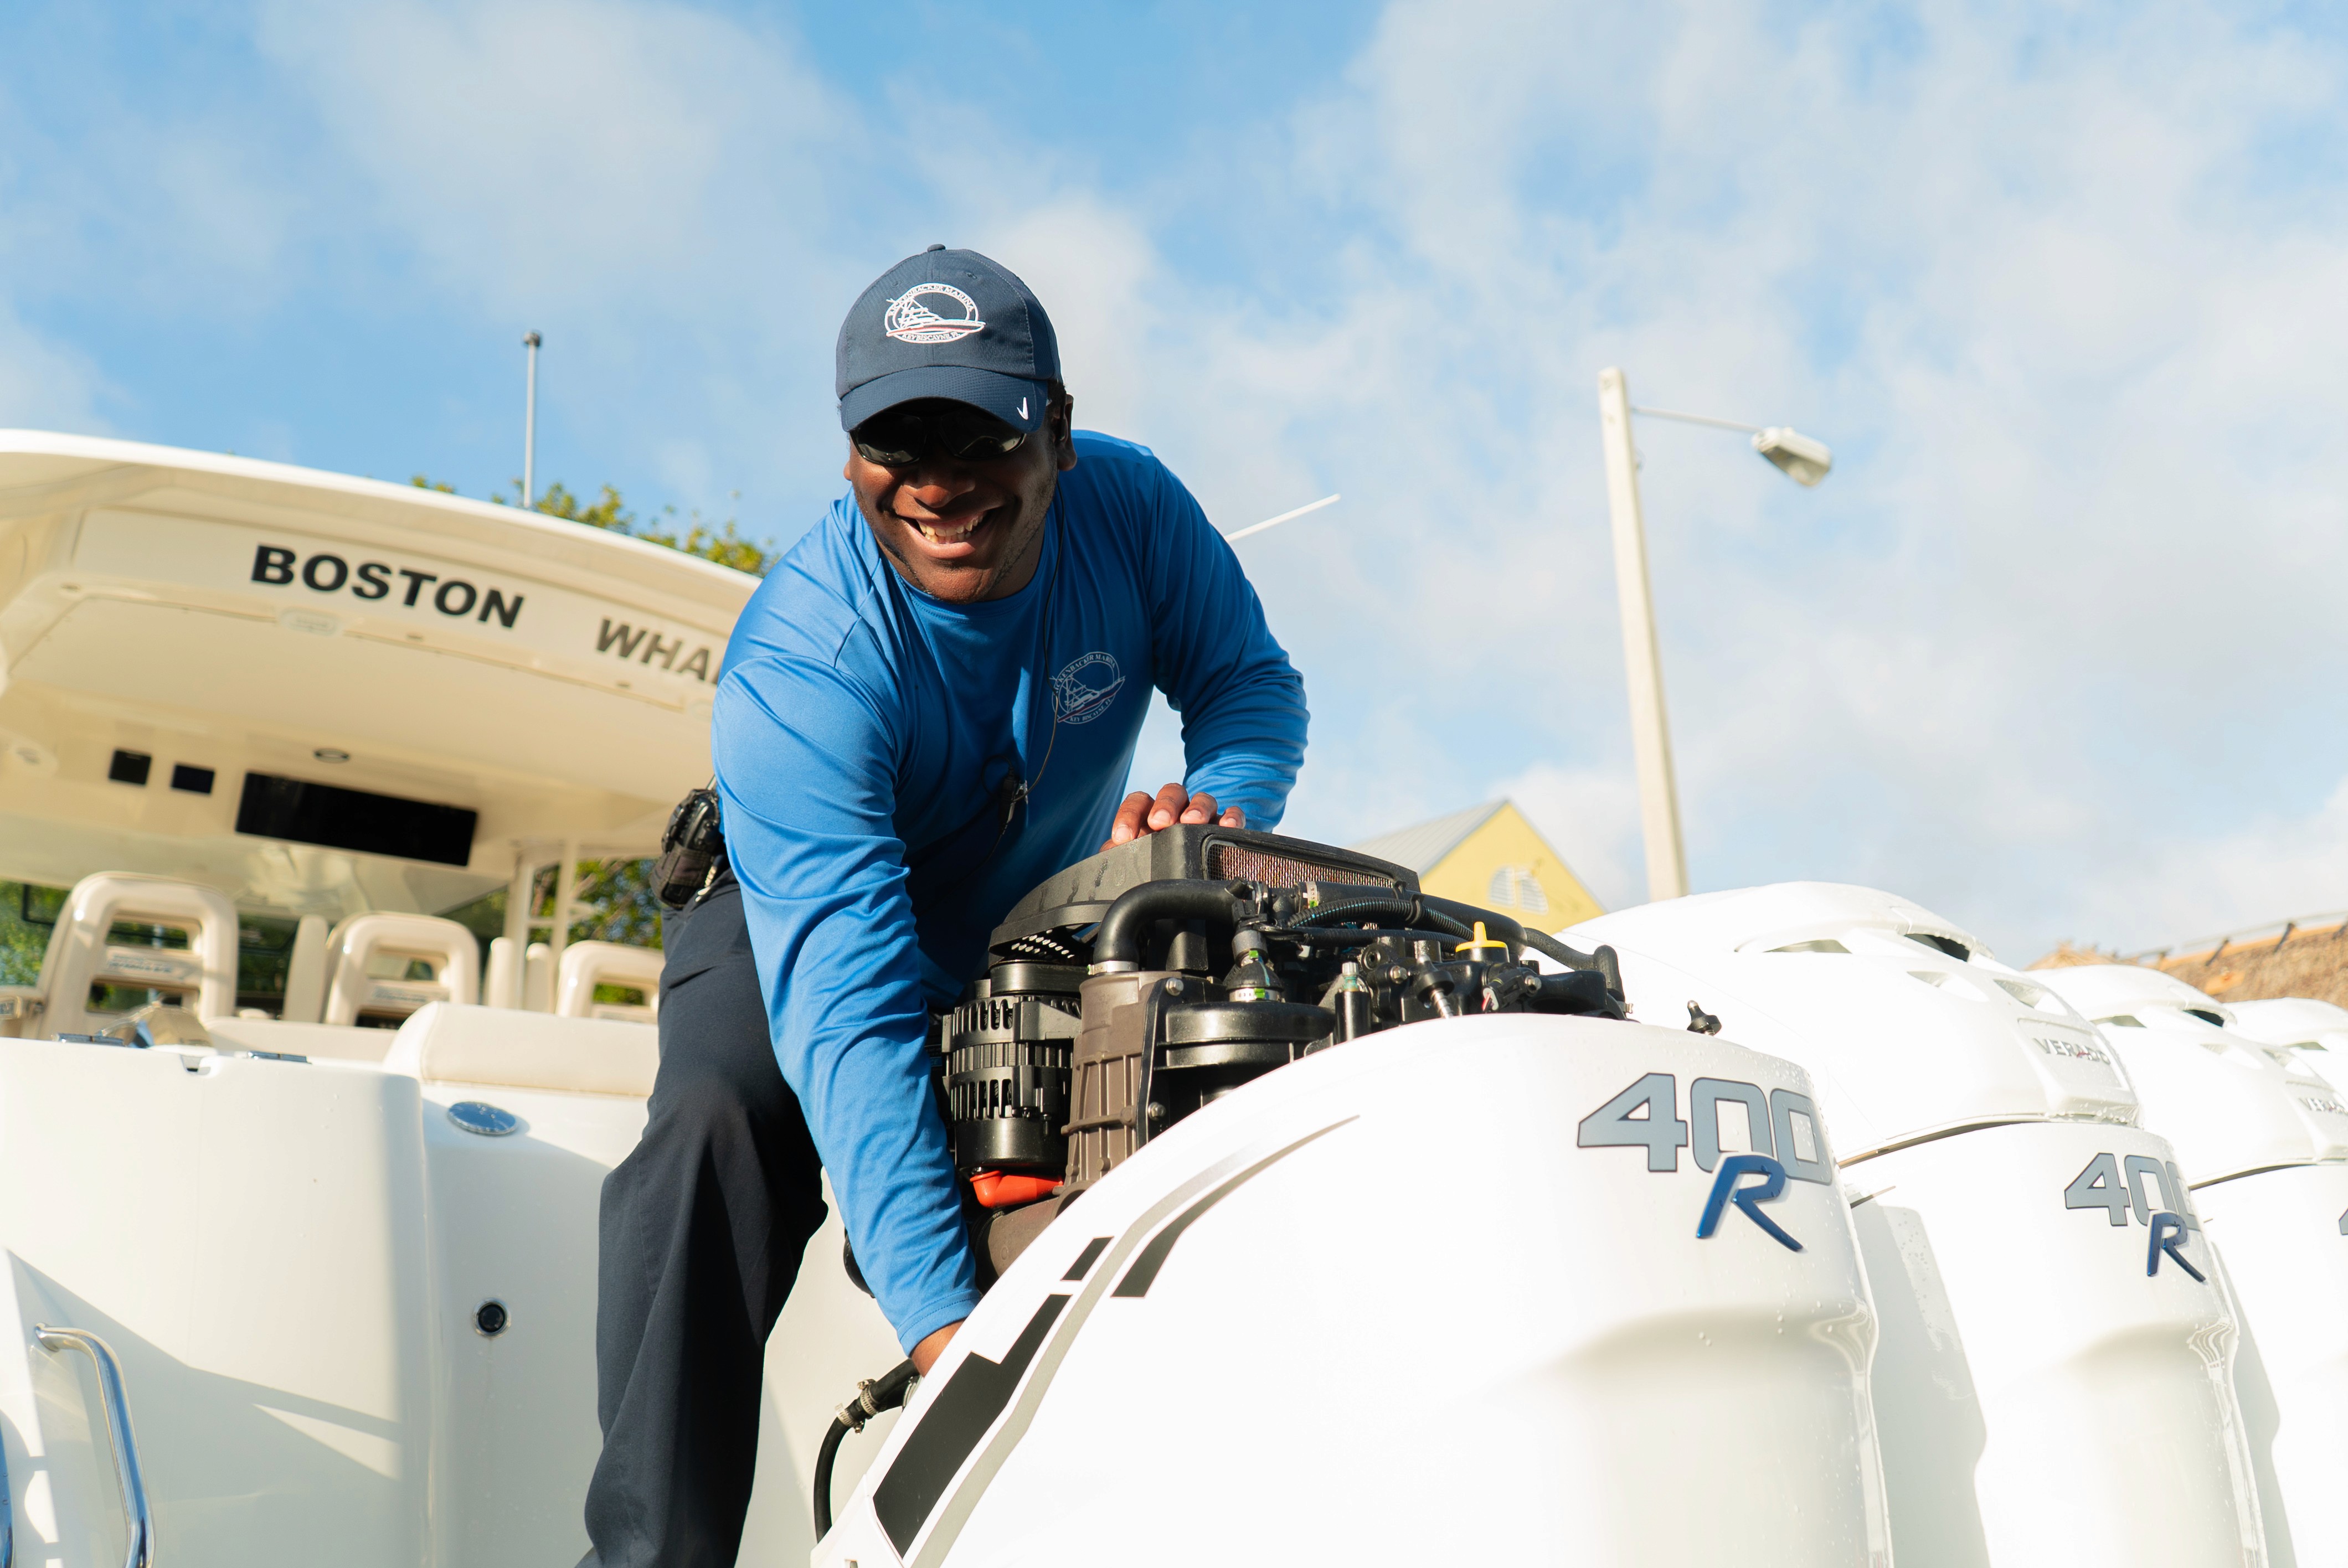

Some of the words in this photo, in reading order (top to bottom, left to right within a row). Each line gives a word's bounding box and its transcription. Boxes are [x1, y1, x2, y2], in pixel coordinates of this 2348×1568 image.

[945, 287, 975, 312] MARINA
[251, 545, 524, 628] BOSTON
[596, 618, 720, 685] WHA
[1095, 654, 1115, 668] MARINA
[2032, 1038, 2111, 1065] VERADO
[1577, 1072, 1832, 1185] 400
[1696, 1153, 1804, 1252] R
[2146, 1212, 2206, 1283] R
